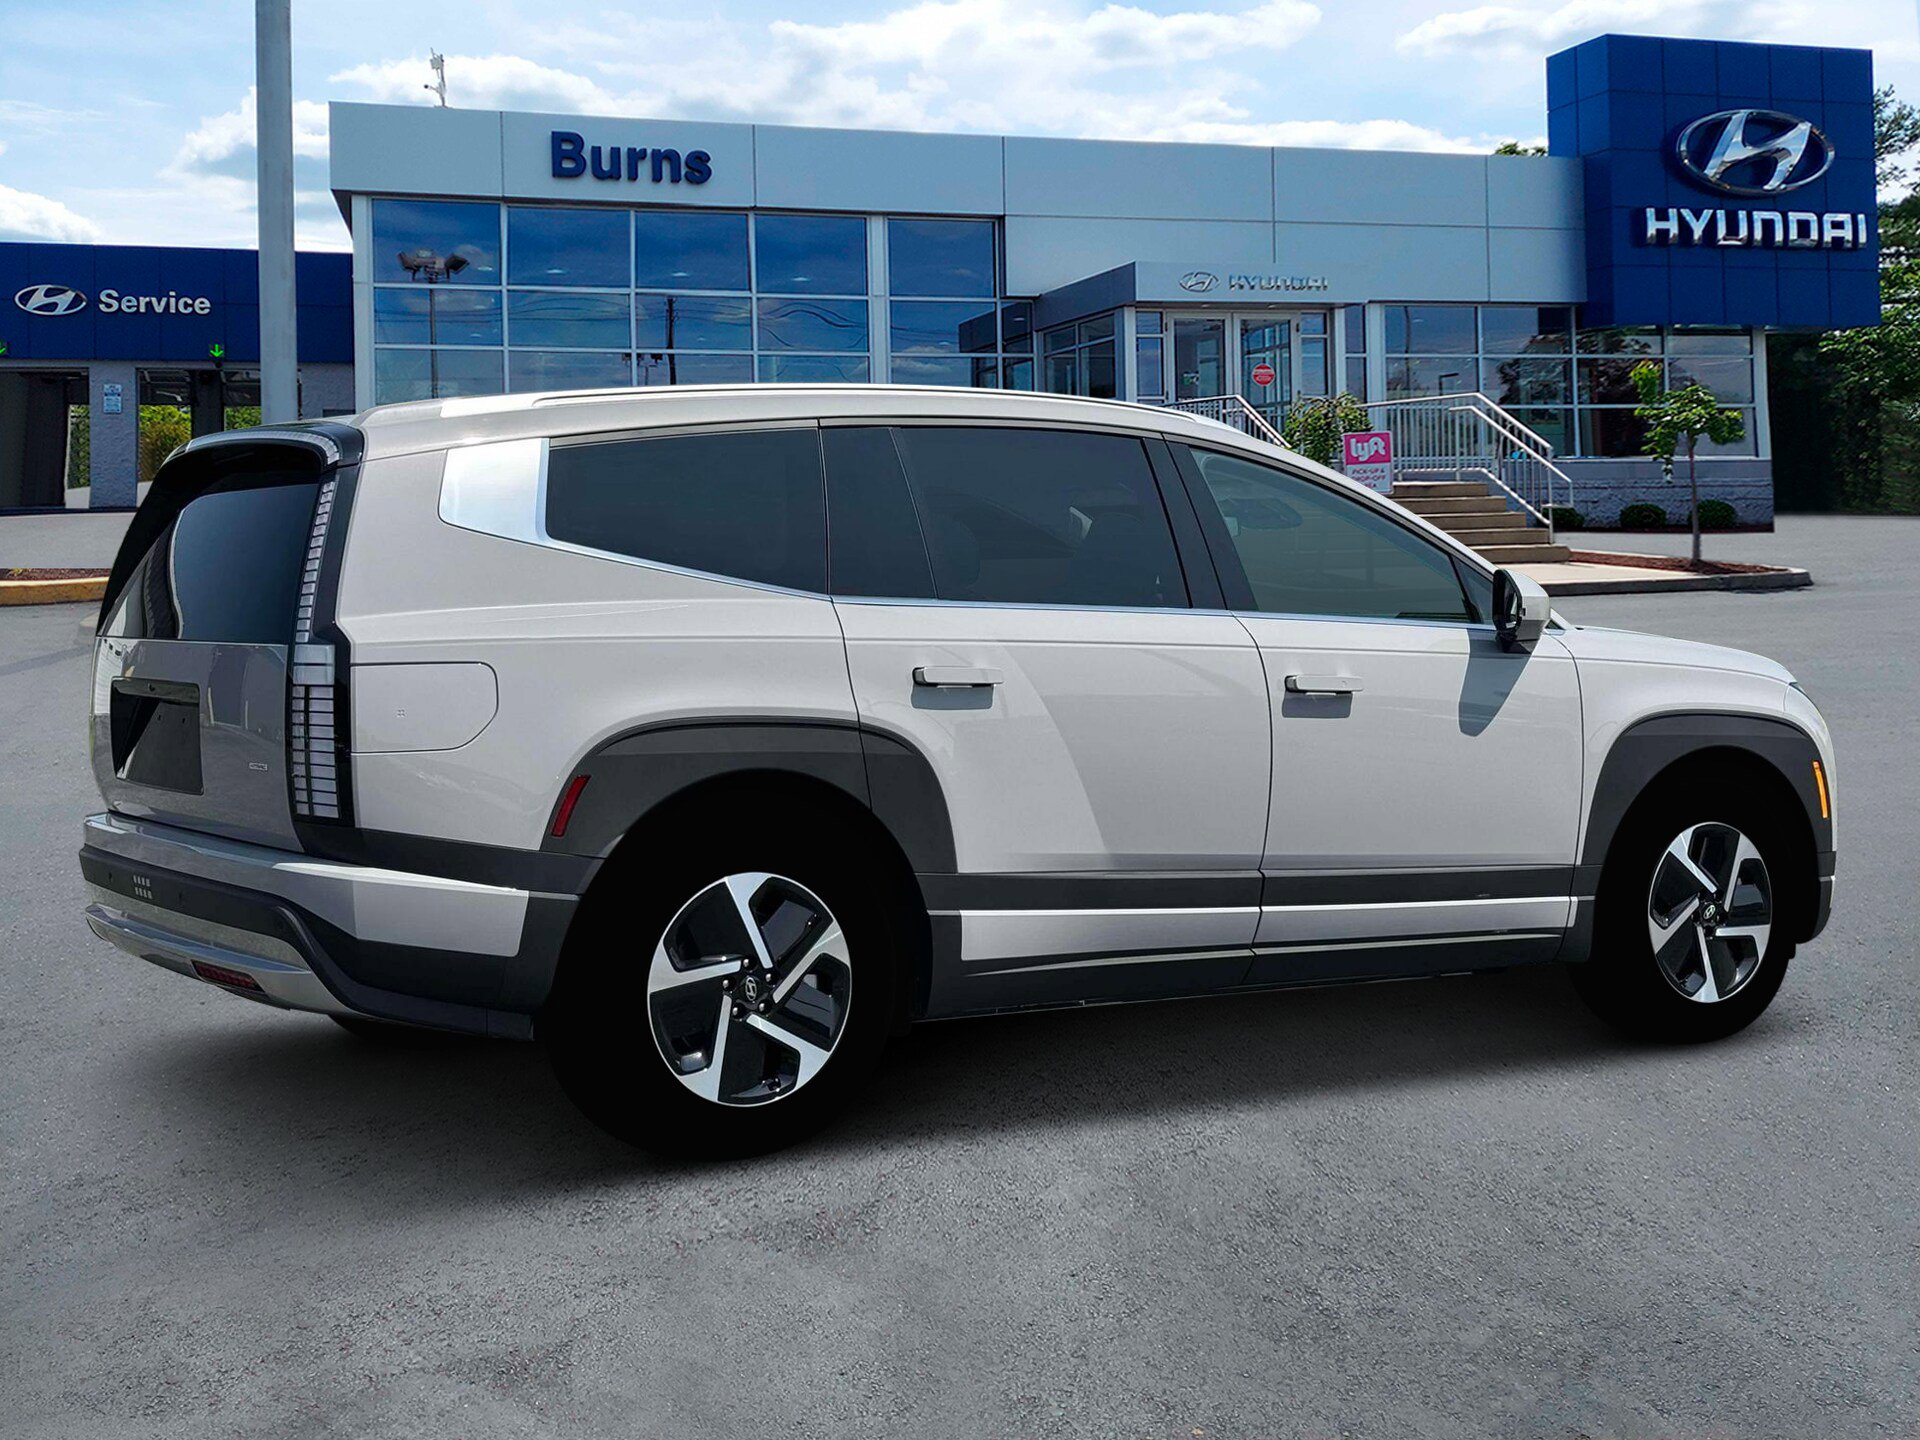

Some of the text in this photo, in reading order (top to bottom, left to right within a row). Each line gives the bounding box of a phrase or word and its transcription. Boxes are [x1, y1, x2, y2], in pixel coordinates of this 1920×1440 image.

[551, 130, 712, 185] Burns
[1645, 207, 1867, 247] HYUNDAI
[1228, 274, 1328, 291] HYUNDAI
[98, 288, 211, 315] Service
[1350, 436, 1386, 461] lyft
